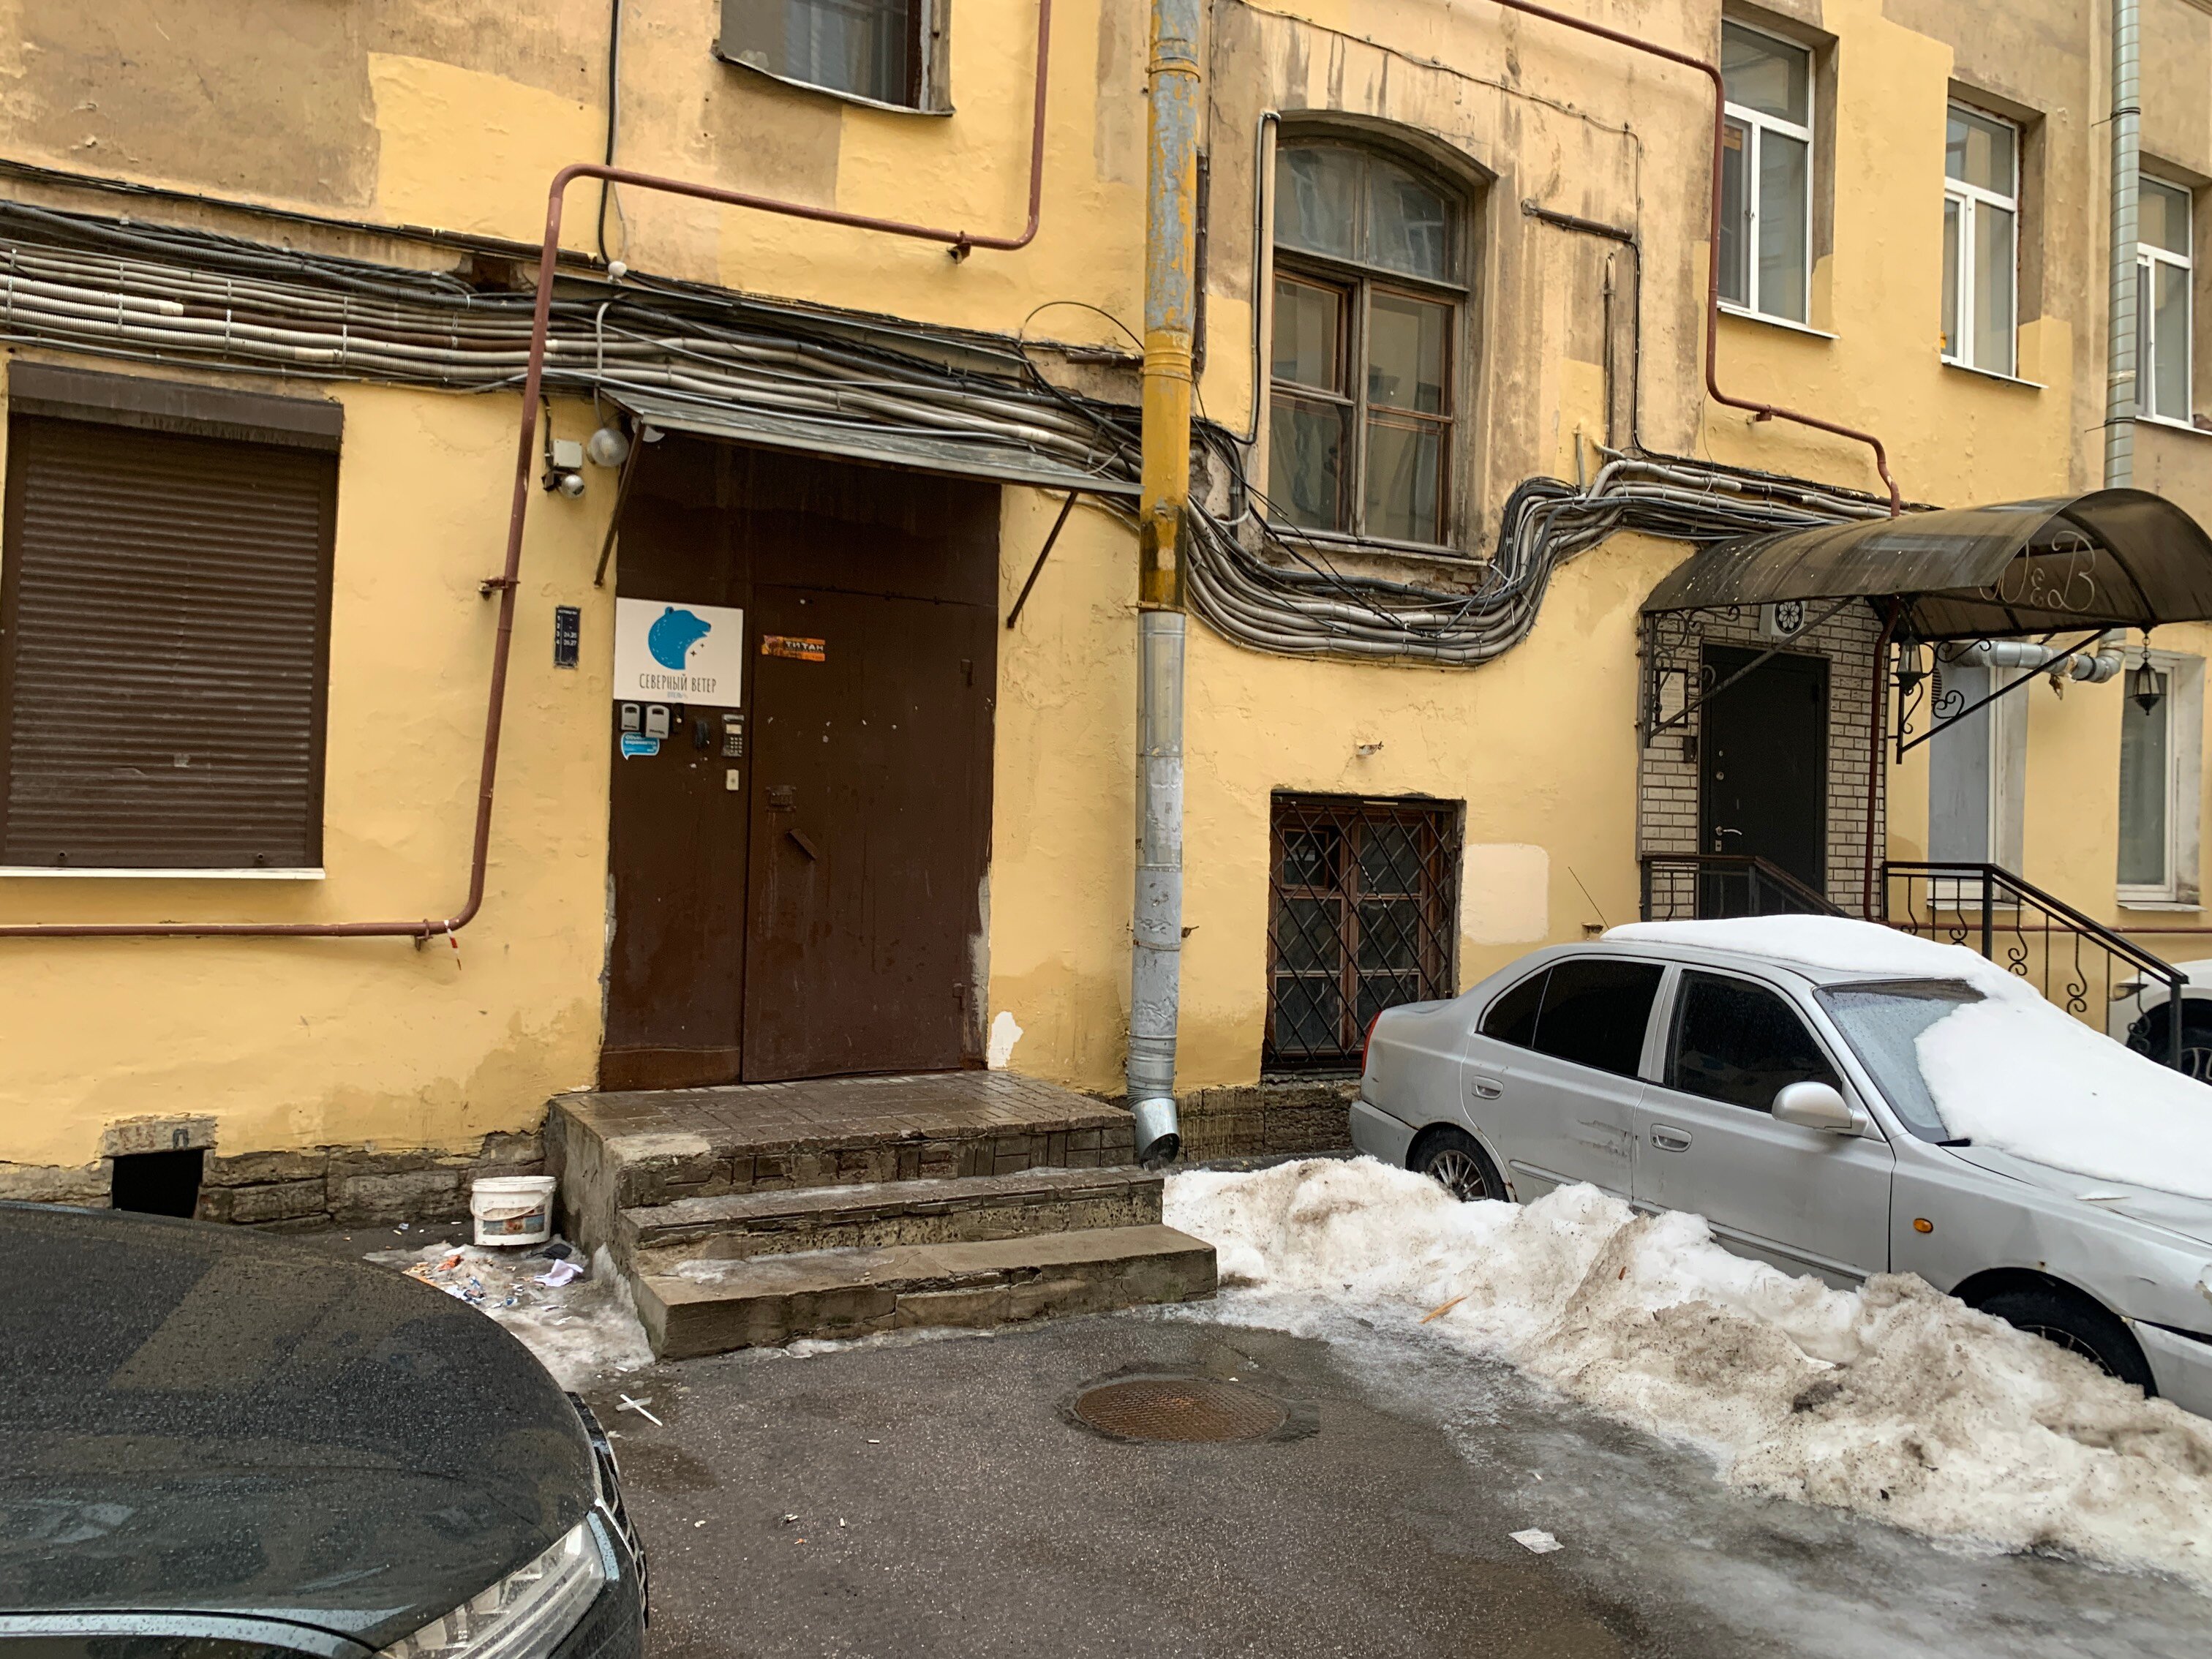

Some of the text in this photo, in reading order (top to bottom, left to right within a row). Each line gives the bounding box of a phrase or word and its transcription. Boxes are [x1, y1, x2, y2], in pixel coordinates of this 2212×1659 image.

[785, 641, 824, 651] ТИТАН
[639, 673, 717, 693] СЕВЕРНЫЙ ВЕТЕР
